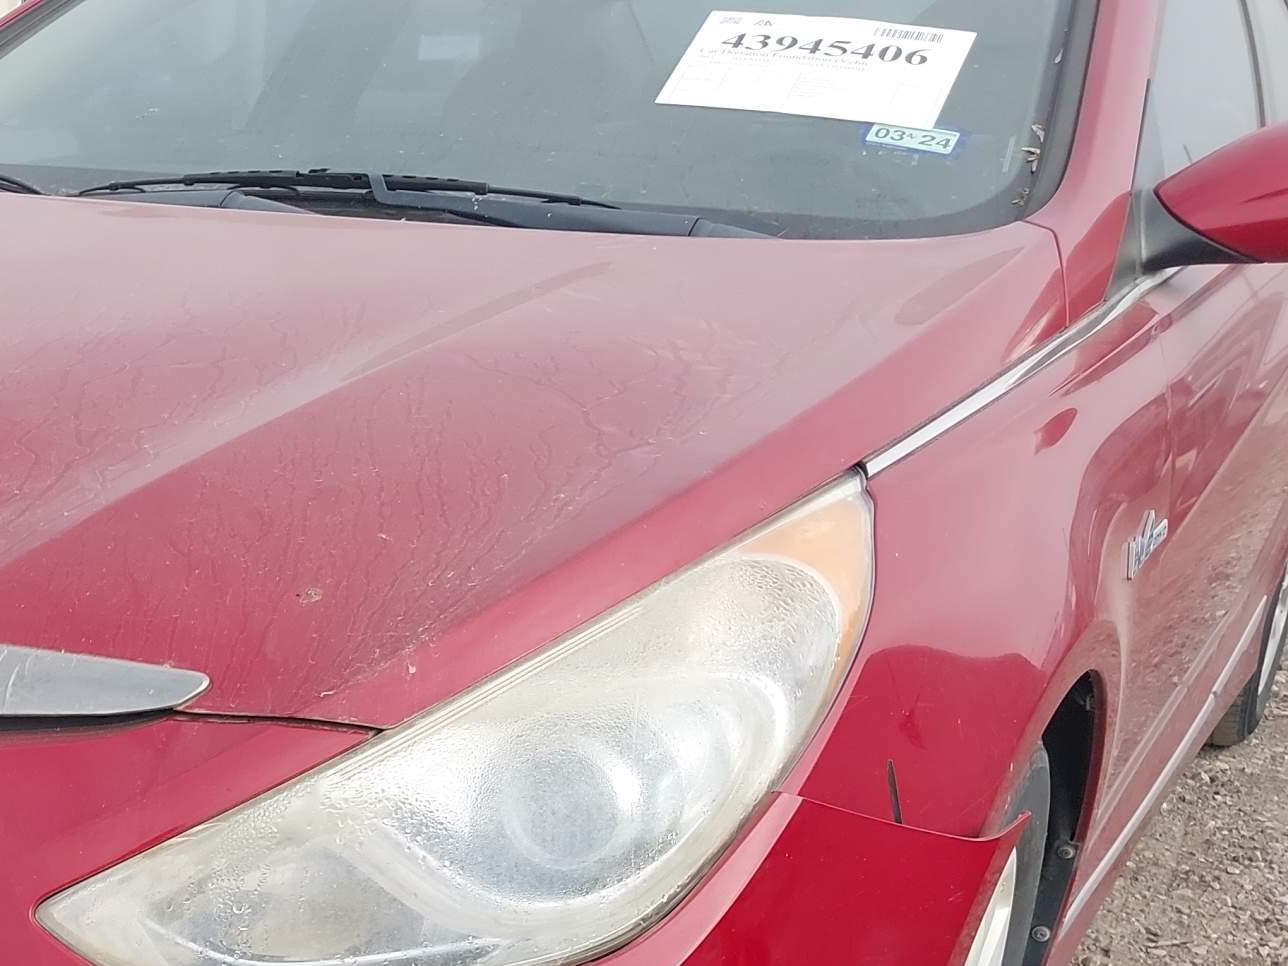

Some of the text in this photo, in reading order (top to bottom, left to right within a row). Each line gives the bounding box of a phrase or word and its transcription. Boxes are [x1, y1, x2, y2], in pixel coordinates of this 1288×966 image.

[721, 32, 930, 66] 43945406
[874, 127, 951, 149] 03 24
